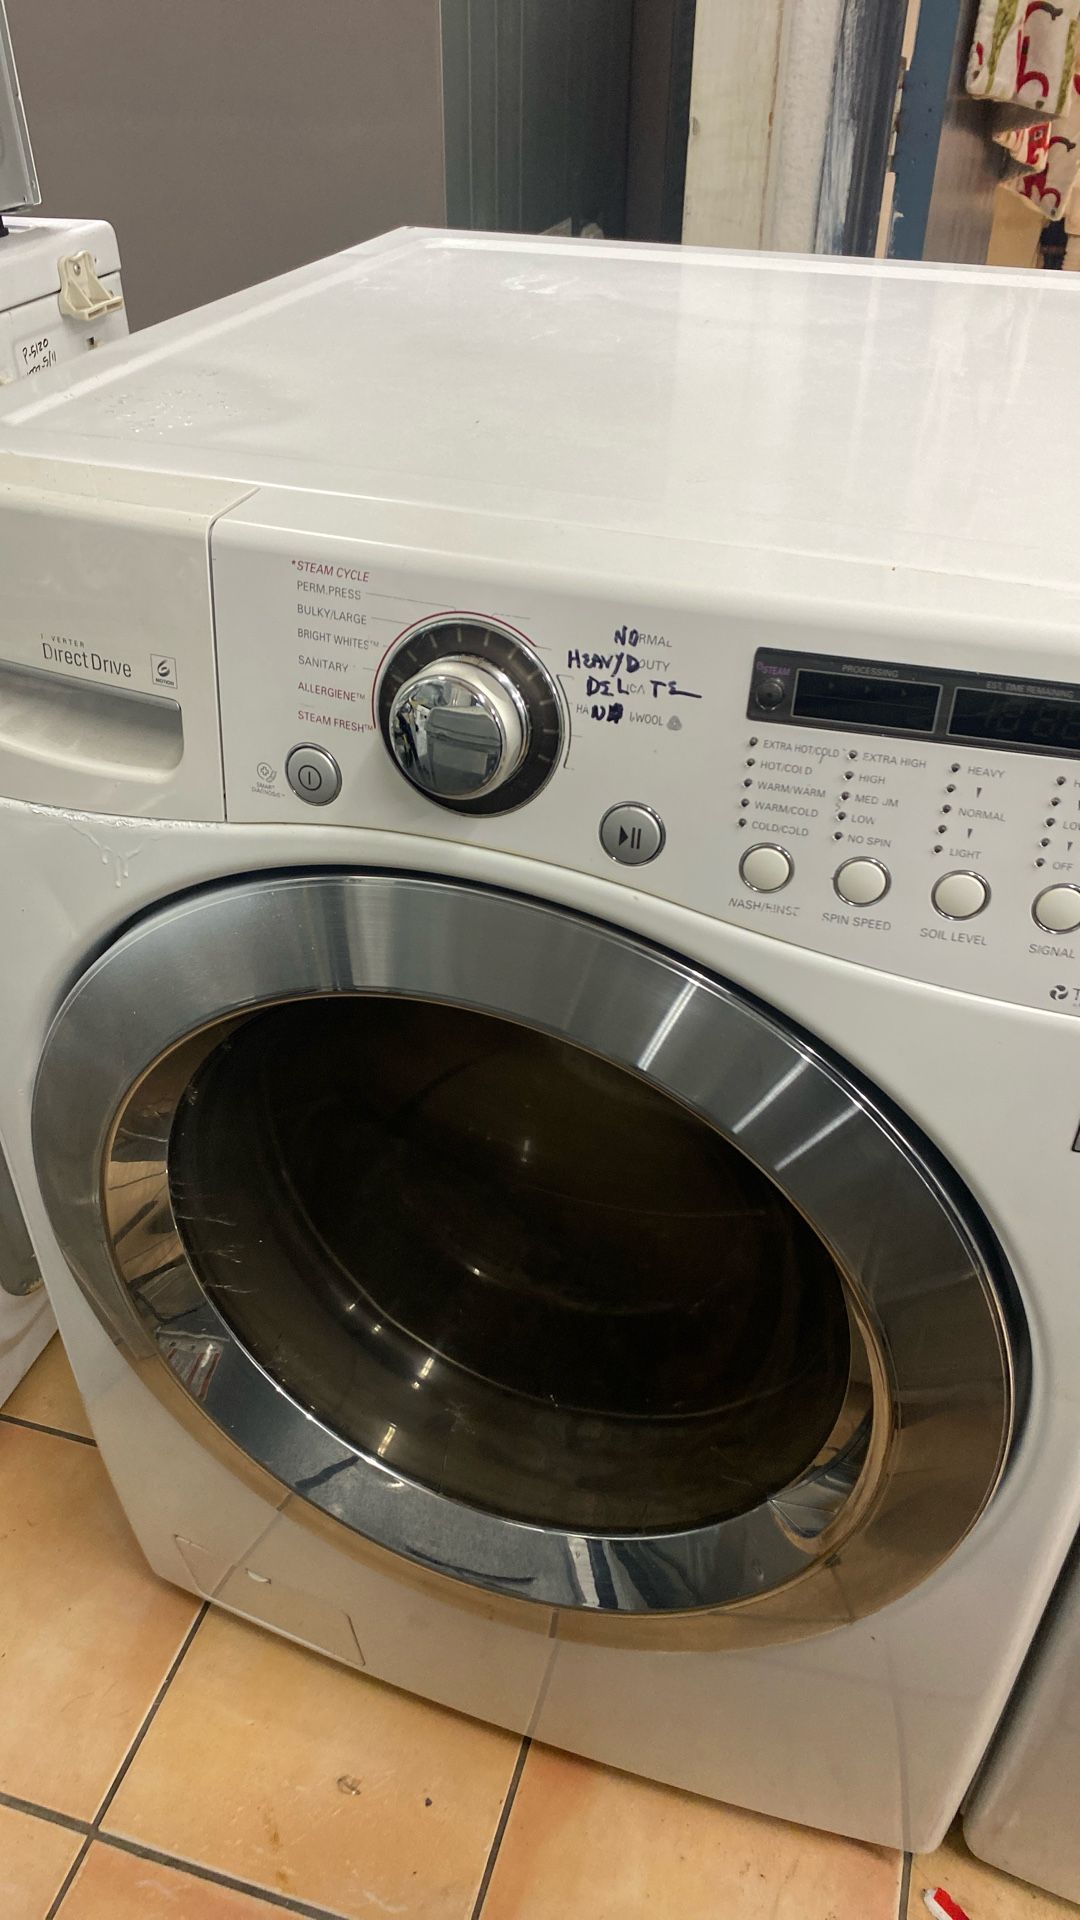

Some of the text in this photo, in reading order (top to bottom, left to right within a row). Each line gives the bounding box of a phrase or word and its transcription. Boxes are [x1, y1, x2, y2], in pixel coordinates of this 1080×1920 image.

[336, 567, 370, 582] CYCLE
[297, 603, 367, 625] BULKY/LARGE
[41, 633, 86, 648] IVERTER
[297, 627, 331, 644] BRIGHT
[614, 625, 673, 648] NORMAL
[42, 642, 132, 678] Direct Drive
[298, 655, 349, 672] SANITARY
[841, 664, 899, 679] PROCESSING
[298, 710, 332, 726] STEAM
[763, 739, 840, 758] EXTRA HOT/COLD
[760, 761, 813, 775] HOT/COLD
[862, 752, 927, 769] EXTRA HIGH
[858, 773, 886, 785] HIGH
[967, 765, 1005, 779] HEAVY
[757, 780, 826, 798] WARM/WARM
[754, 800, 819, 818] WARM/COLD
[854, 793, 899, 808] MEDUM
[958, 807, 1006, 822] NORMAL
[751, 820, 809, 837] COLD/COLD
[847, 833, 892, 849] NO SPIN
[949, 847, 982, 860] LIGHT
[1052, 861, 1074, 872] OFF
[821, 912, 892, 932] SPIN SPEED
[920, 927, 987, 946] SOIL LEVEL
[1028, 943, 1076, 960] SIGNAL
